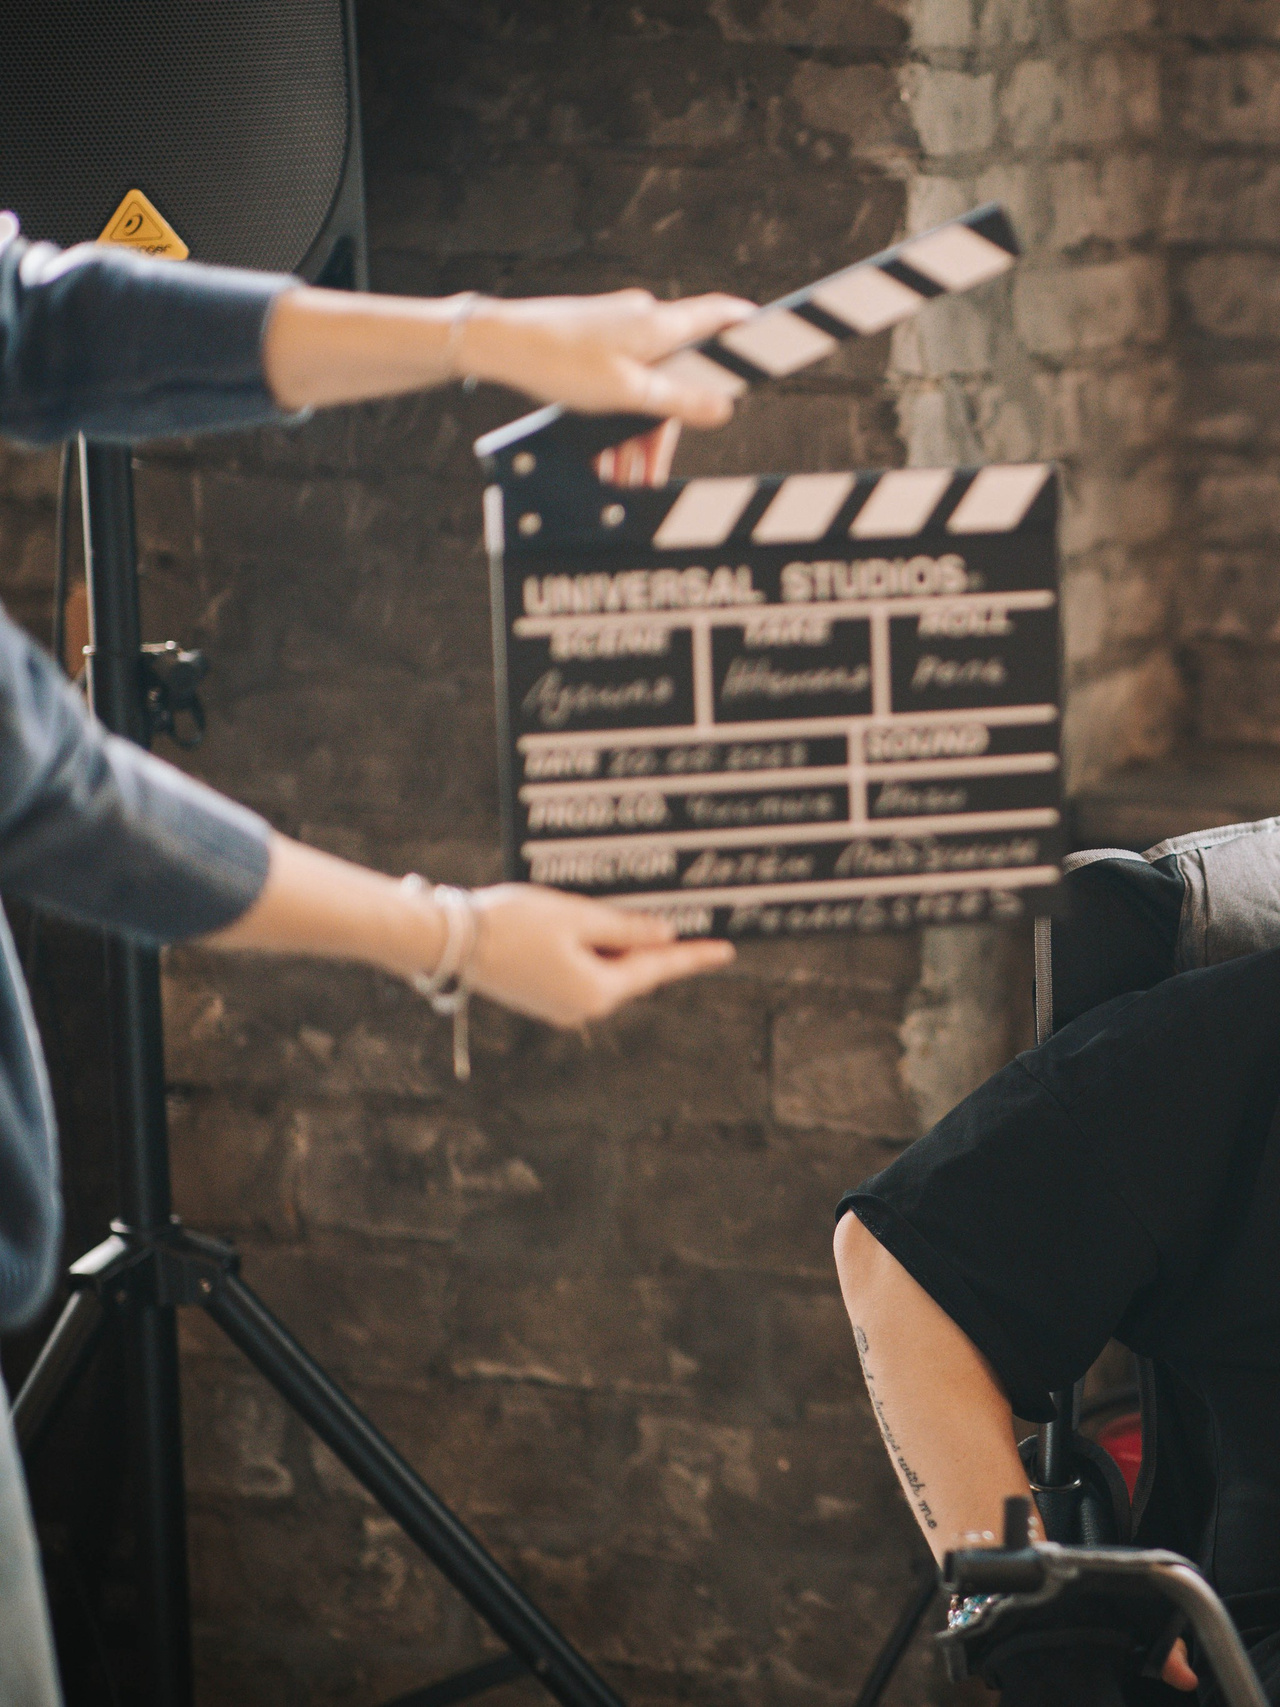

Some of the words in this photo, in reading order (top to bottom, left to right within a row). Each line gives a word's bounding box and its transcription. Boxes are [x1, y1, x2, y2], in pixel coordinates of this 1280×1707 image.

[523, 564, 767, 616] UNIVERSAL
[779, 553, 970, 601] STUDIOS
[530, 847, 677, 884] DIRECTOR
[897, 1455, 926, 1498] with
[917, 1499, 938, 1530] me
